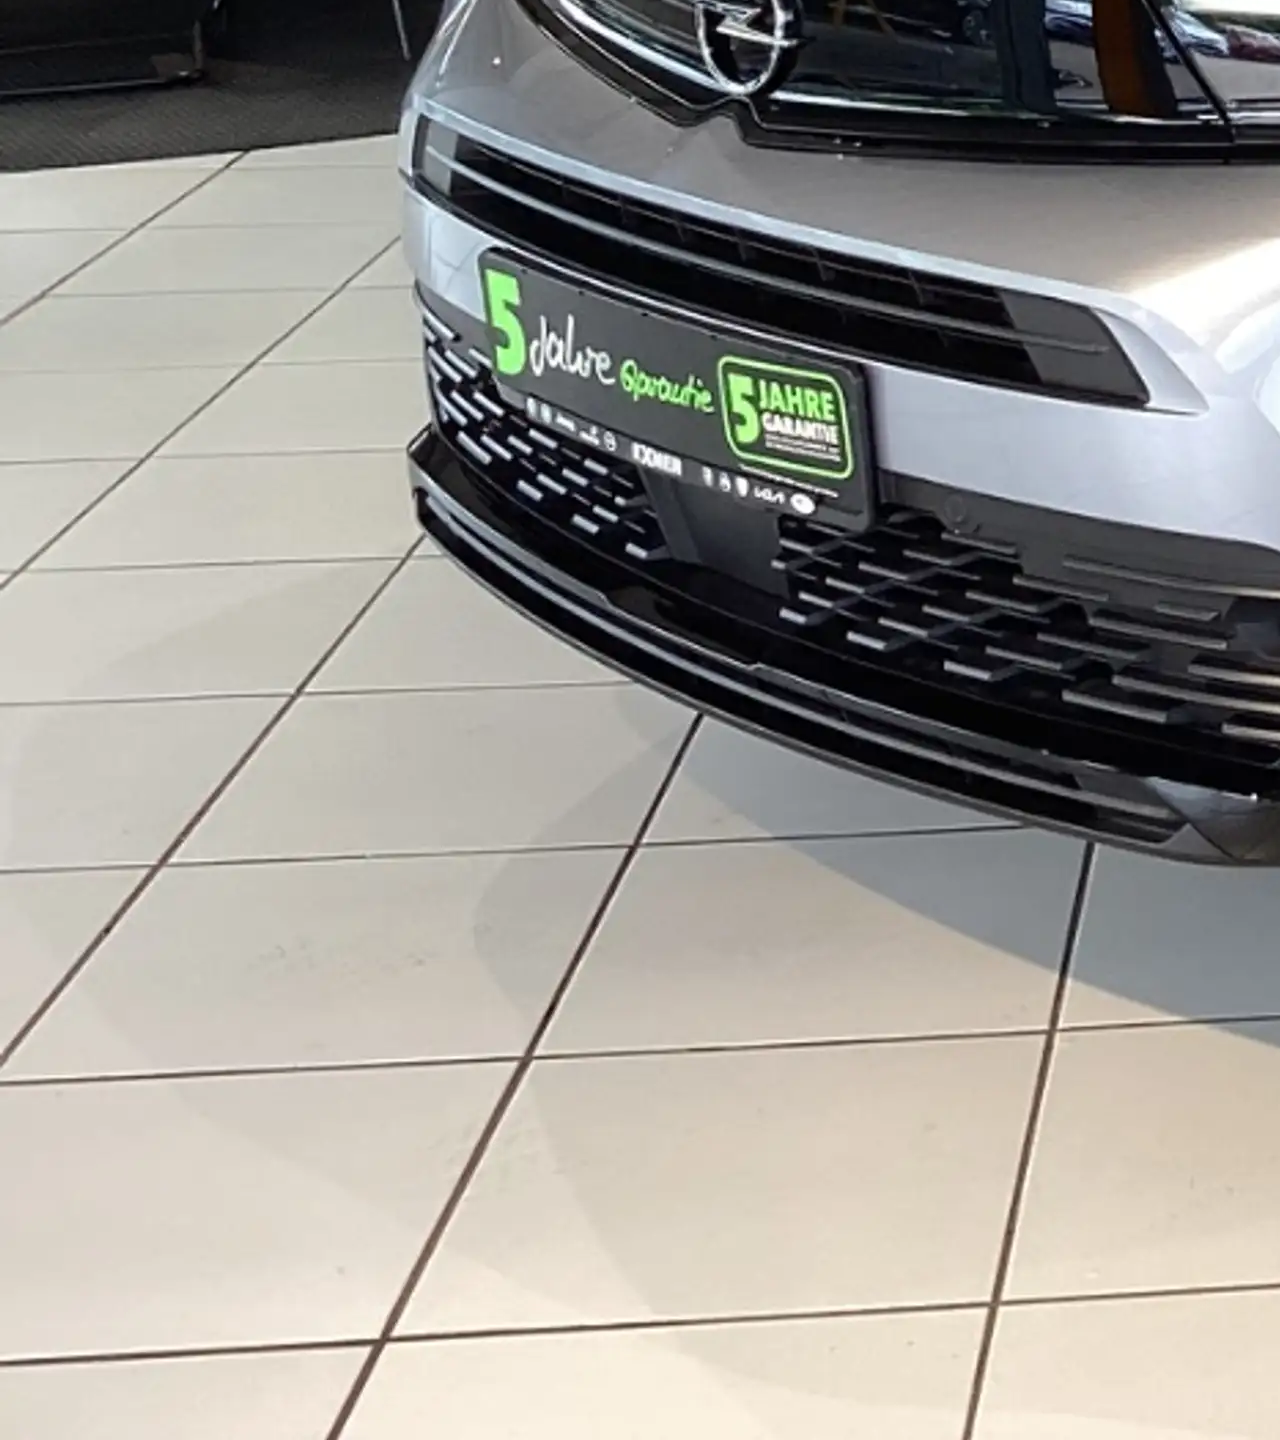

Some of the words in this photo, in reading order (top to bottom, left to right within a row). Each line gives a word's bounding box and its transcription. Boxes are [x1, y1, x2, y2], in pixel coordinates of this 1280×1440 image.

[484, 268, 526, 375] 5
[528, 313, 616, 385] Jahre
[728, 373, 761, 444] 5
[759, 378, 837, 422] JAHRE
[761, 411, 841, 445] GARANTIE
